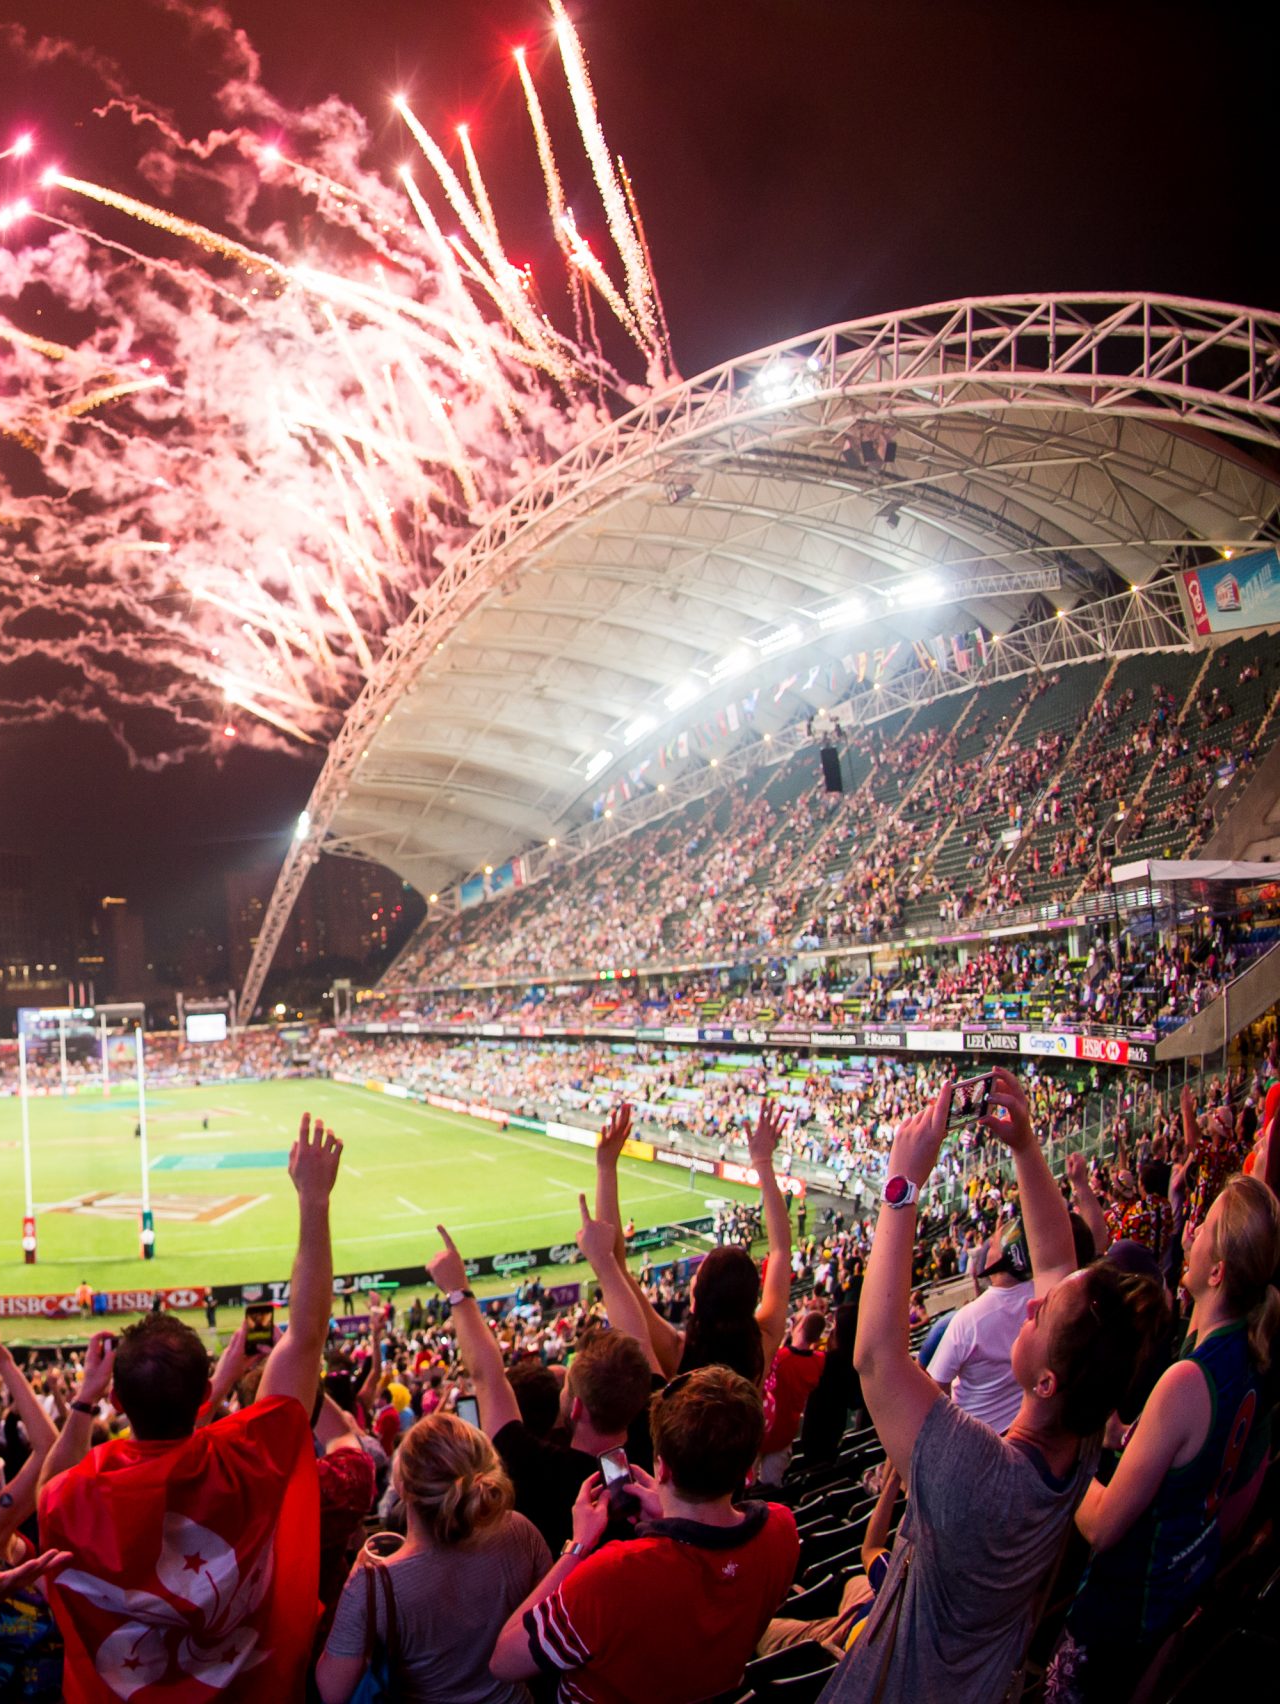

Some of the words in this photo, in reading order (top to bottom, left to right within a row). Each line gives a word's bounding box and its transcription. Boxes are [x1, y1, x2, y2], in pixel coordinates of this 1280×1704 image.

[1030, 1036, 1055, 1053] Cimigo
[1082, 1038, 1107, 1059] HSBC
[106, 1292, 162, 1312] HSB
